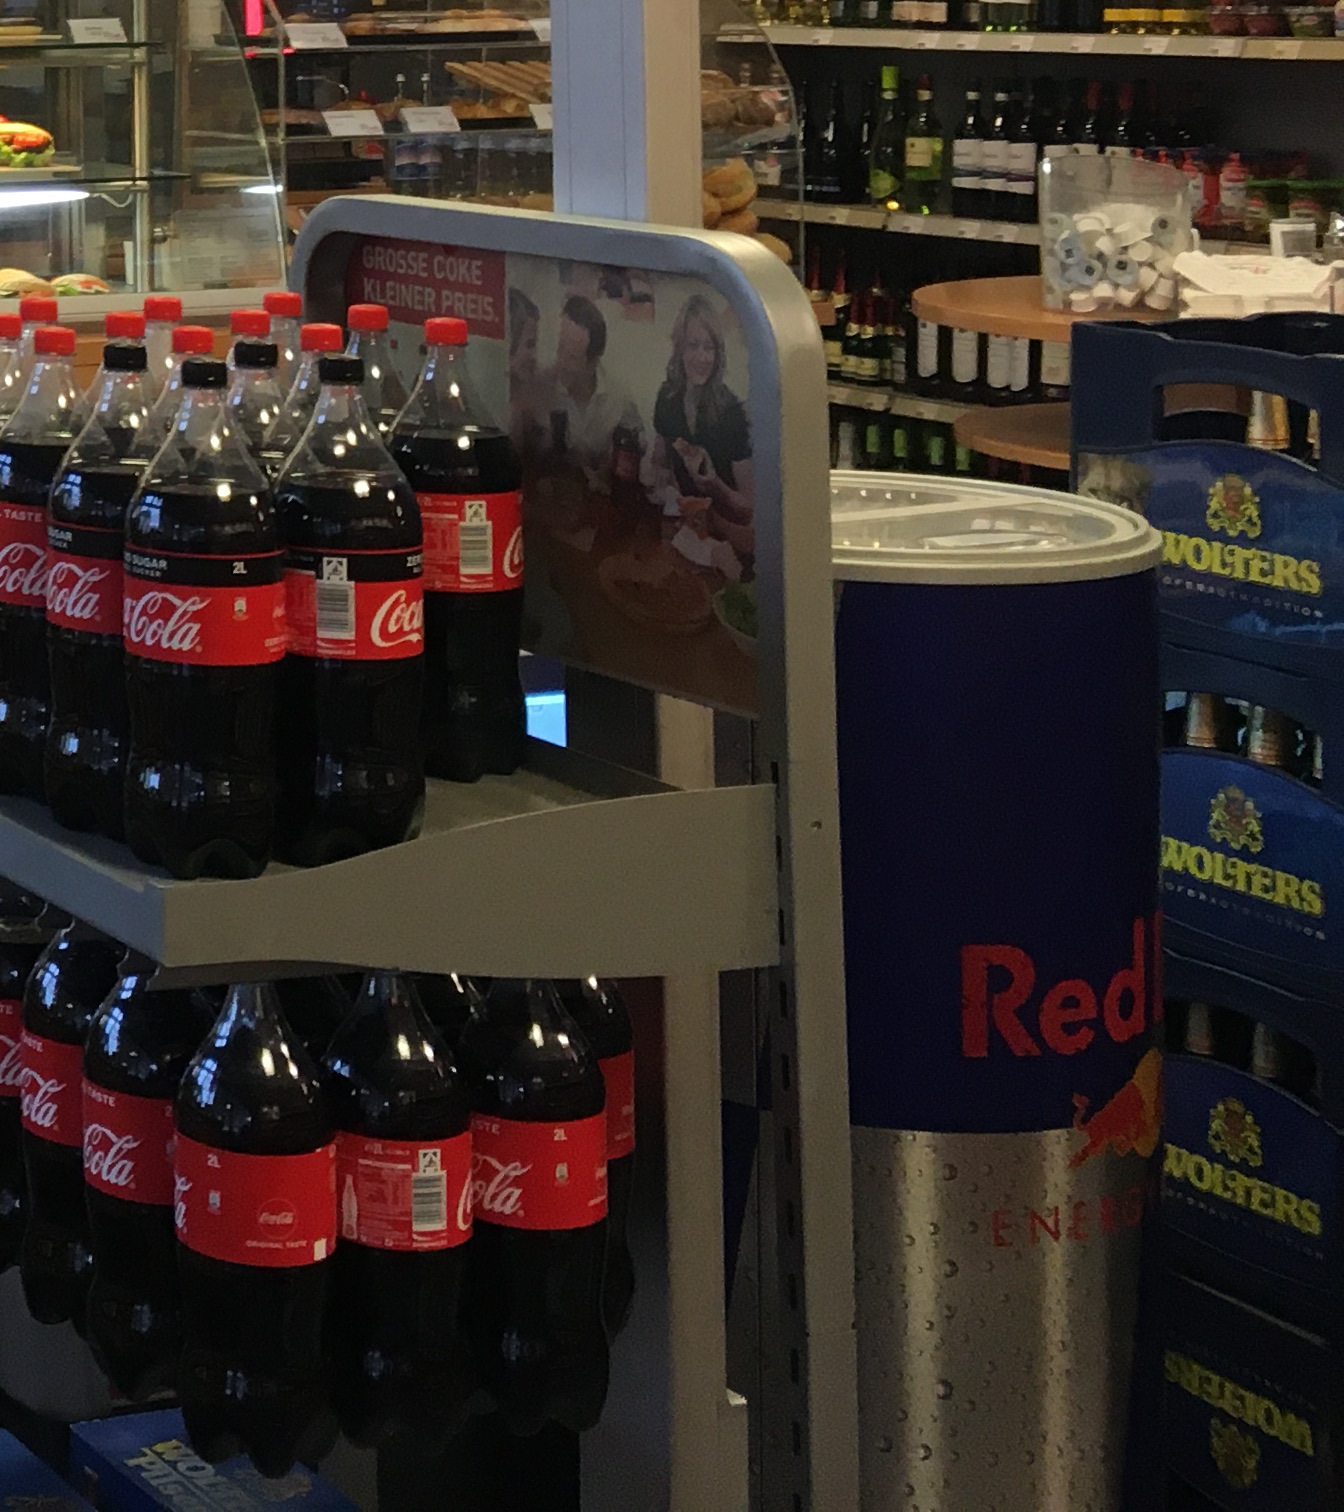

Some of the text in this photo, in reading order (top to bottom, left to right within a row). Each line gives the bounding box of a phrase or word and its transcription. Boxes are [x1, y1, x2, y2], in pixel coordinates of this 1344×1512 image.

[362, 244, 482, 285] GROSSE COKE
[364, 277, 436, 313] KLEINER
[9, 508, 44, 523] TASTE
[132, 552, 248, 575] SUGAR 2L
[1162, 531, 1323, 598] WOLTERS
[1161, 837, 1325, 918] WOLTERS
[960, 916, 1148, 1059] Red
[554, 1127, 568, 1142] 2L
[207, 1153, 222, 1169] 2L
[1164, 1142, 1322, 1237] WOLTERS
